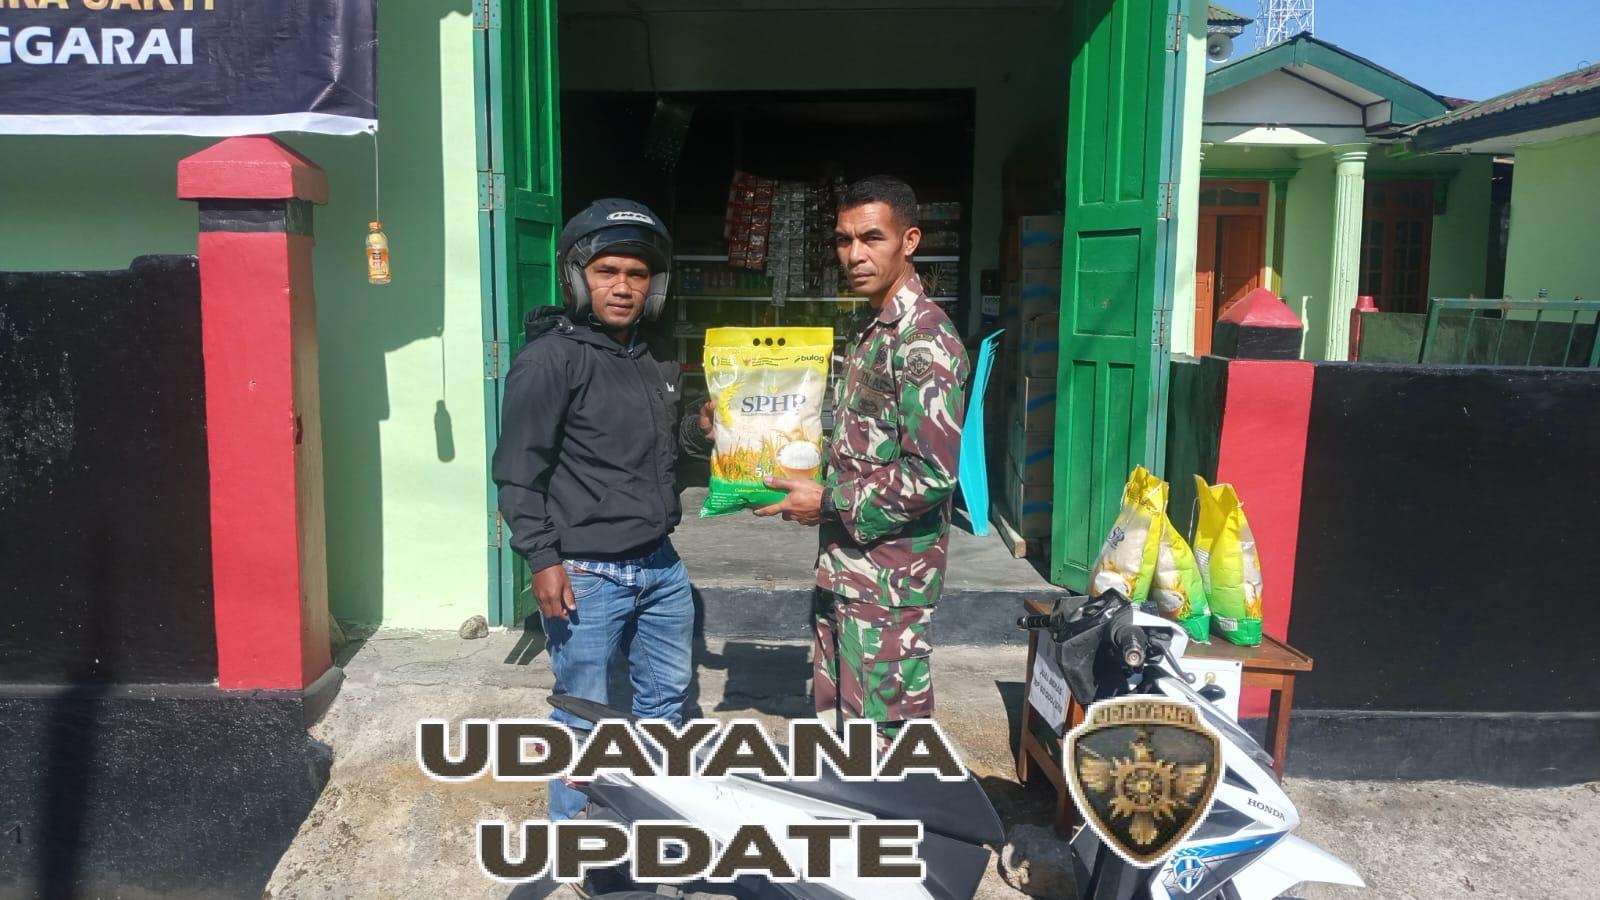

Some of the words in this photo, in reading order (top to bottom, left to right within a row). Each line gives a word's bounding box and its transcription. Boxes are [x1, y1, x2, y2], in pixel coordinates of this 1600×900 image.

[0, 26, 194, 65] GARAI
[800, 354, 824, 364] bulog
[1247, 797, 1286, 822] HONDA
